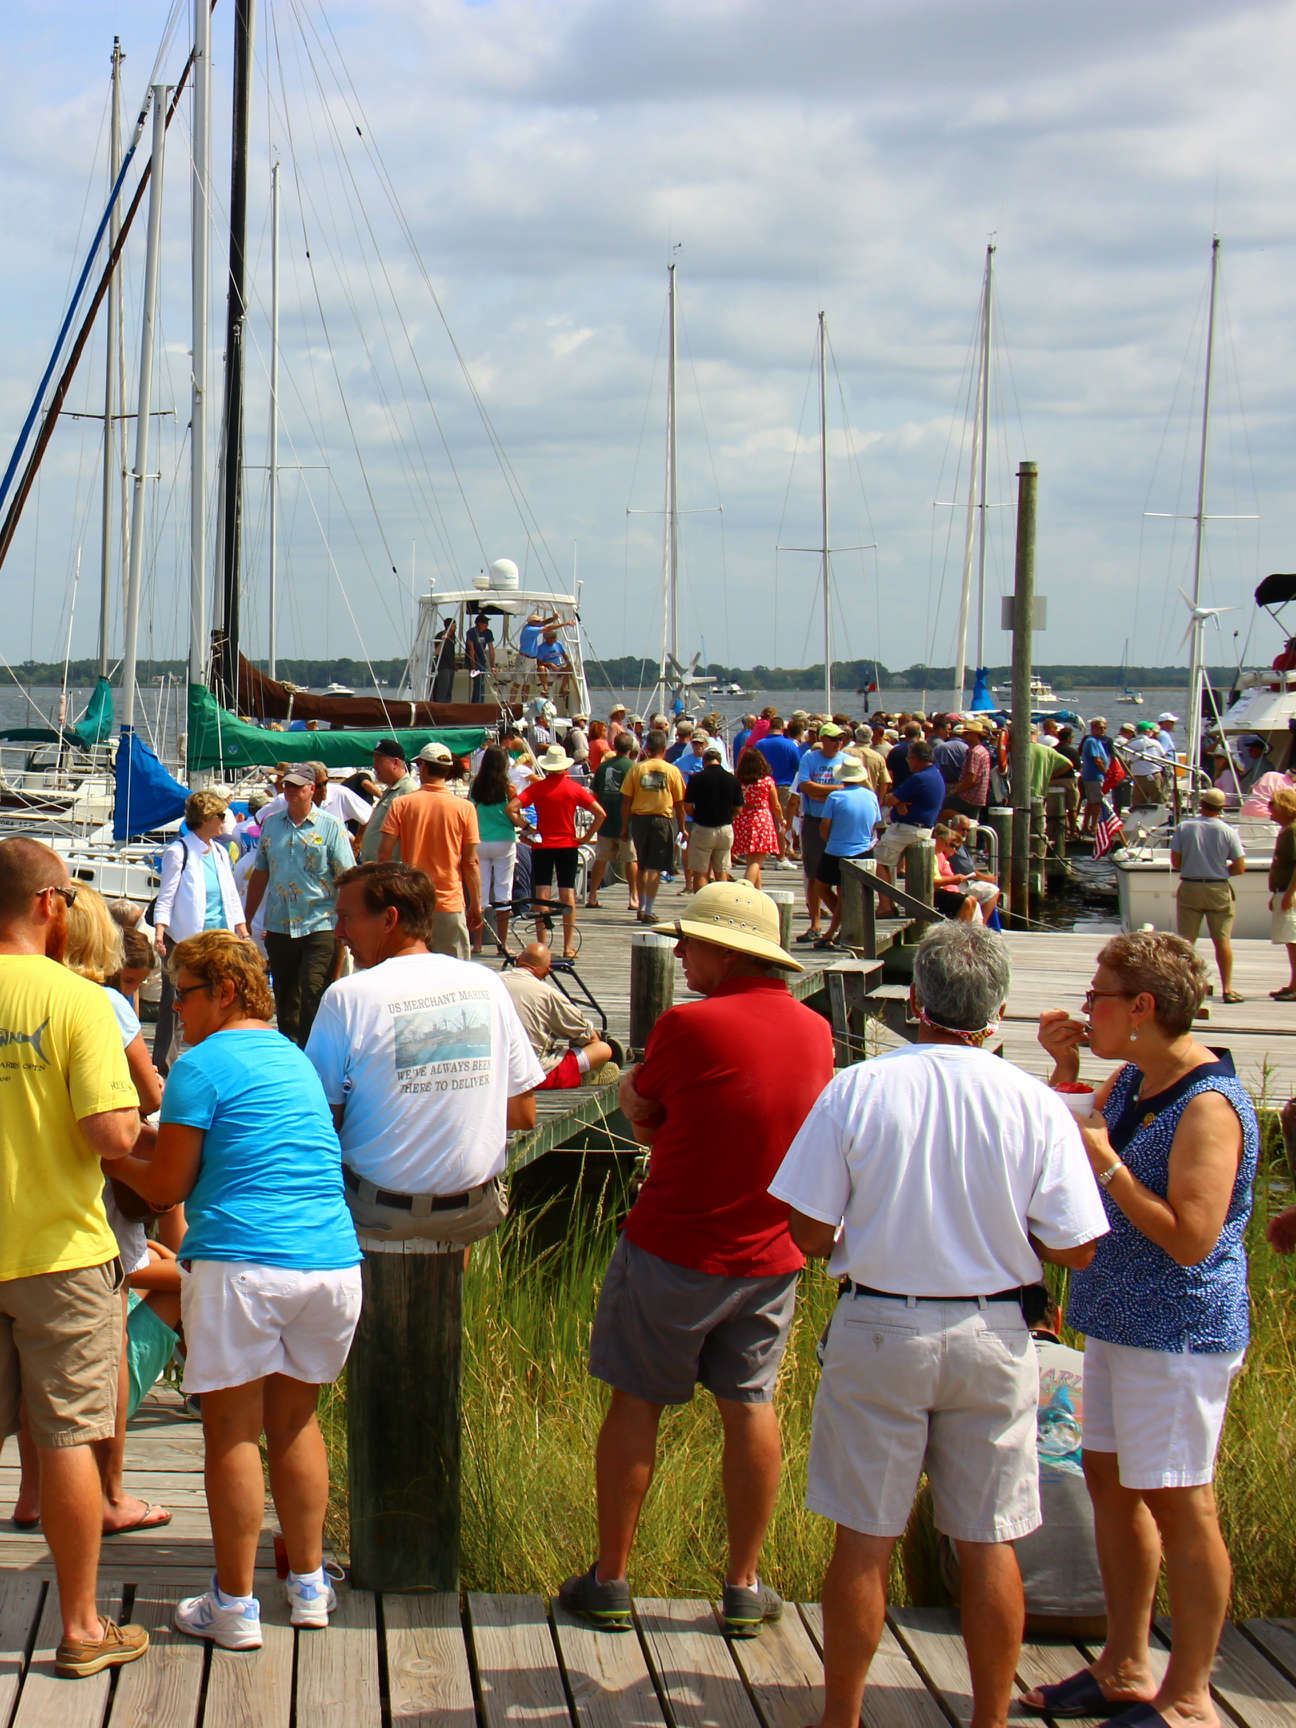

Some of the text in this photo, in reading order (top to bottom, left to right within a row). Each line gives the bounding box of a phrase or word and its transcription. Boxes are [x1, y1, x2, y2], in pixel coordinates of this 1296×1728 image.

[388, 1002, 402, 1014] US
[404, 992, 457, 1012] MERCHANT
[397, 1064, 427, 1081] WE'VE
[430, 1060, 470, 1075] ALWAYS
[400, 1074, 490, 1094] THERE TO DELIVER
